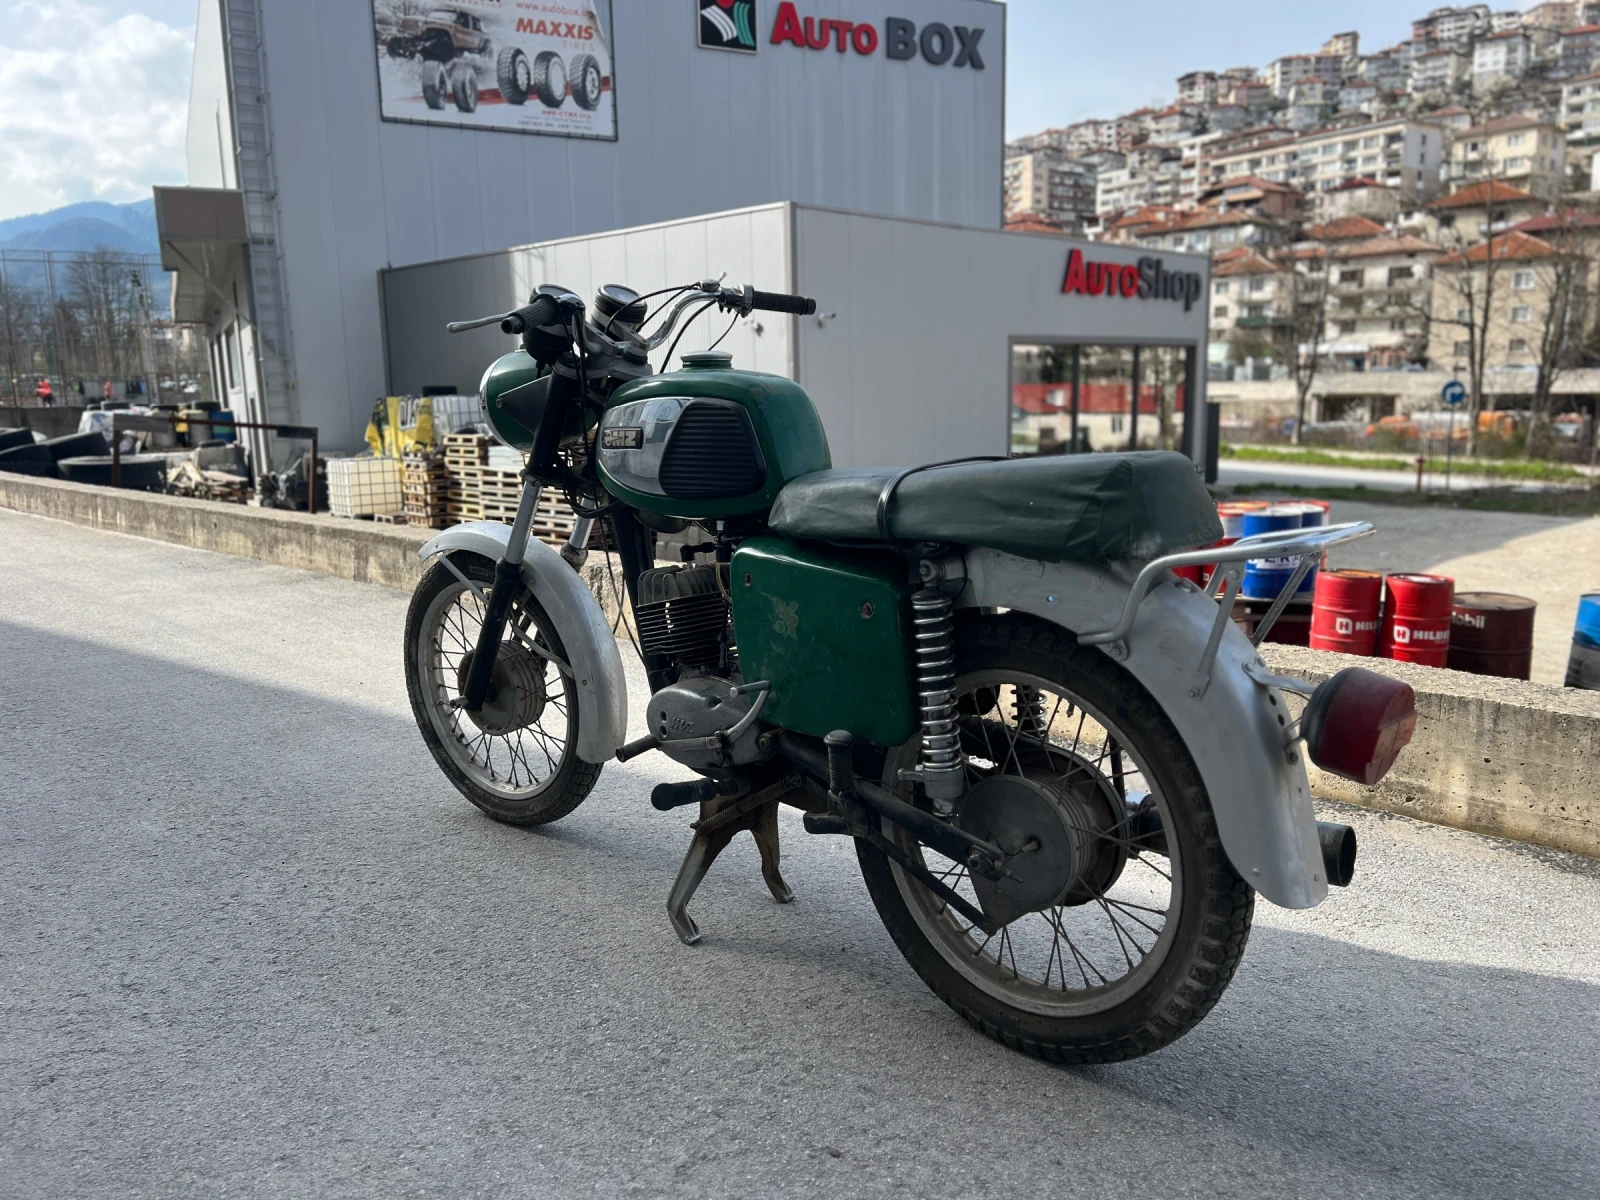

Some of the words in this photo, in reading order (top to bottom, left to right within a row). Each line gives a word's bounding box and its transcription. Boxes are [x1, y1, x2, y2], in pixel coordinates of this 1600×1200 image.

[516, 17, 594, 41] MAXXIS
[771, 1, 878, 55] AUTO
[886, 16, 985, 69] BOX
[562, 40, 595, 52] TIRES
